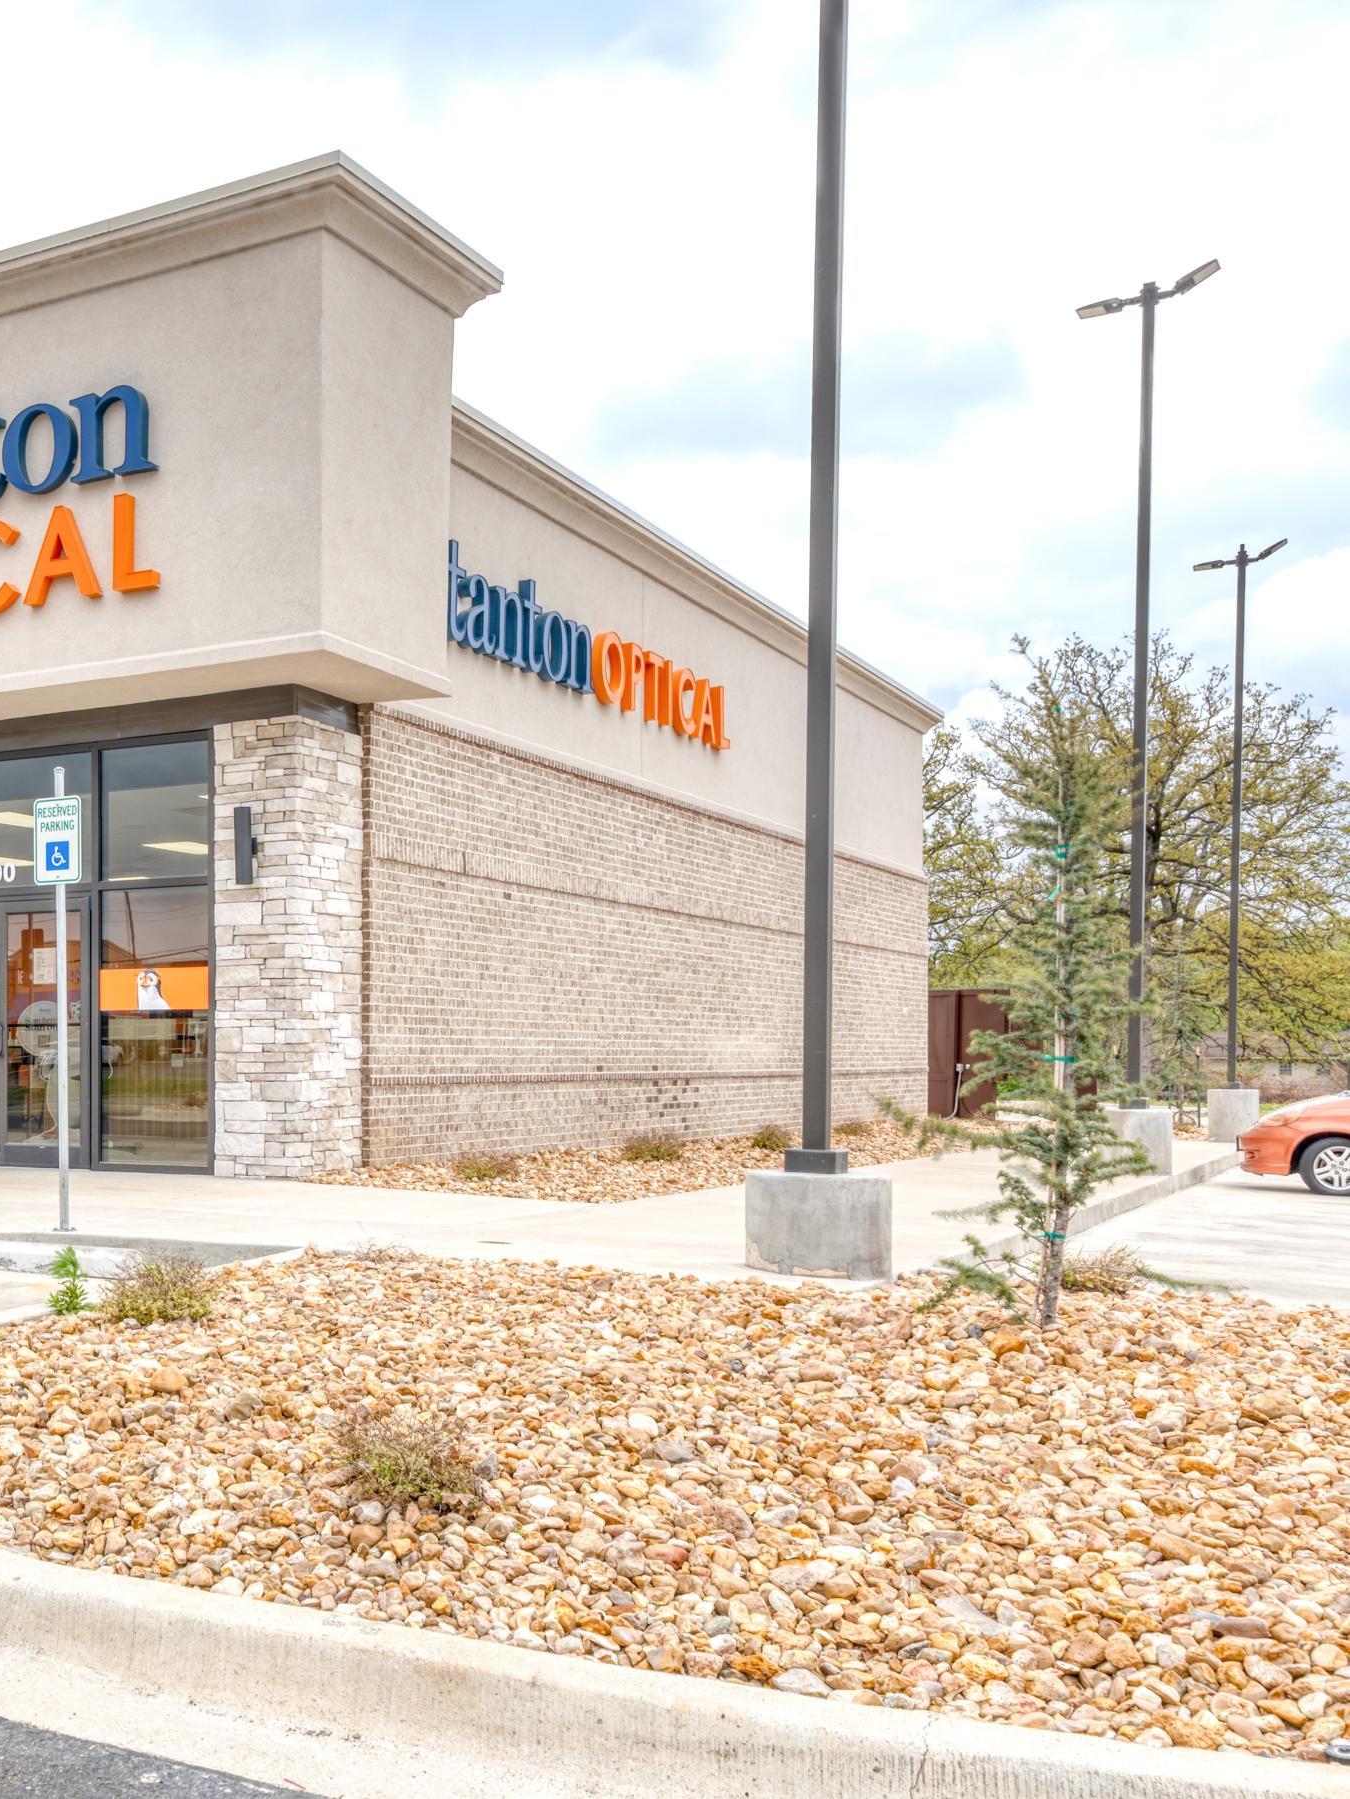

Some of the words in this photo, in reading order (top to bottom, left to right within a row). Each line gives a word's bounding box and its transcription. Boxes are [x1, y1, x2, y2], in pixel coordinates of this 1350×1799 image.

[446, 539, 595, 695] tanton
[591, 631, 731, 750] OPTICAL
[37, 804, 77, 819] RESERVED
[40, 819, 75, 833] PARKING
[24, 1016, 41, 1024] Scan
